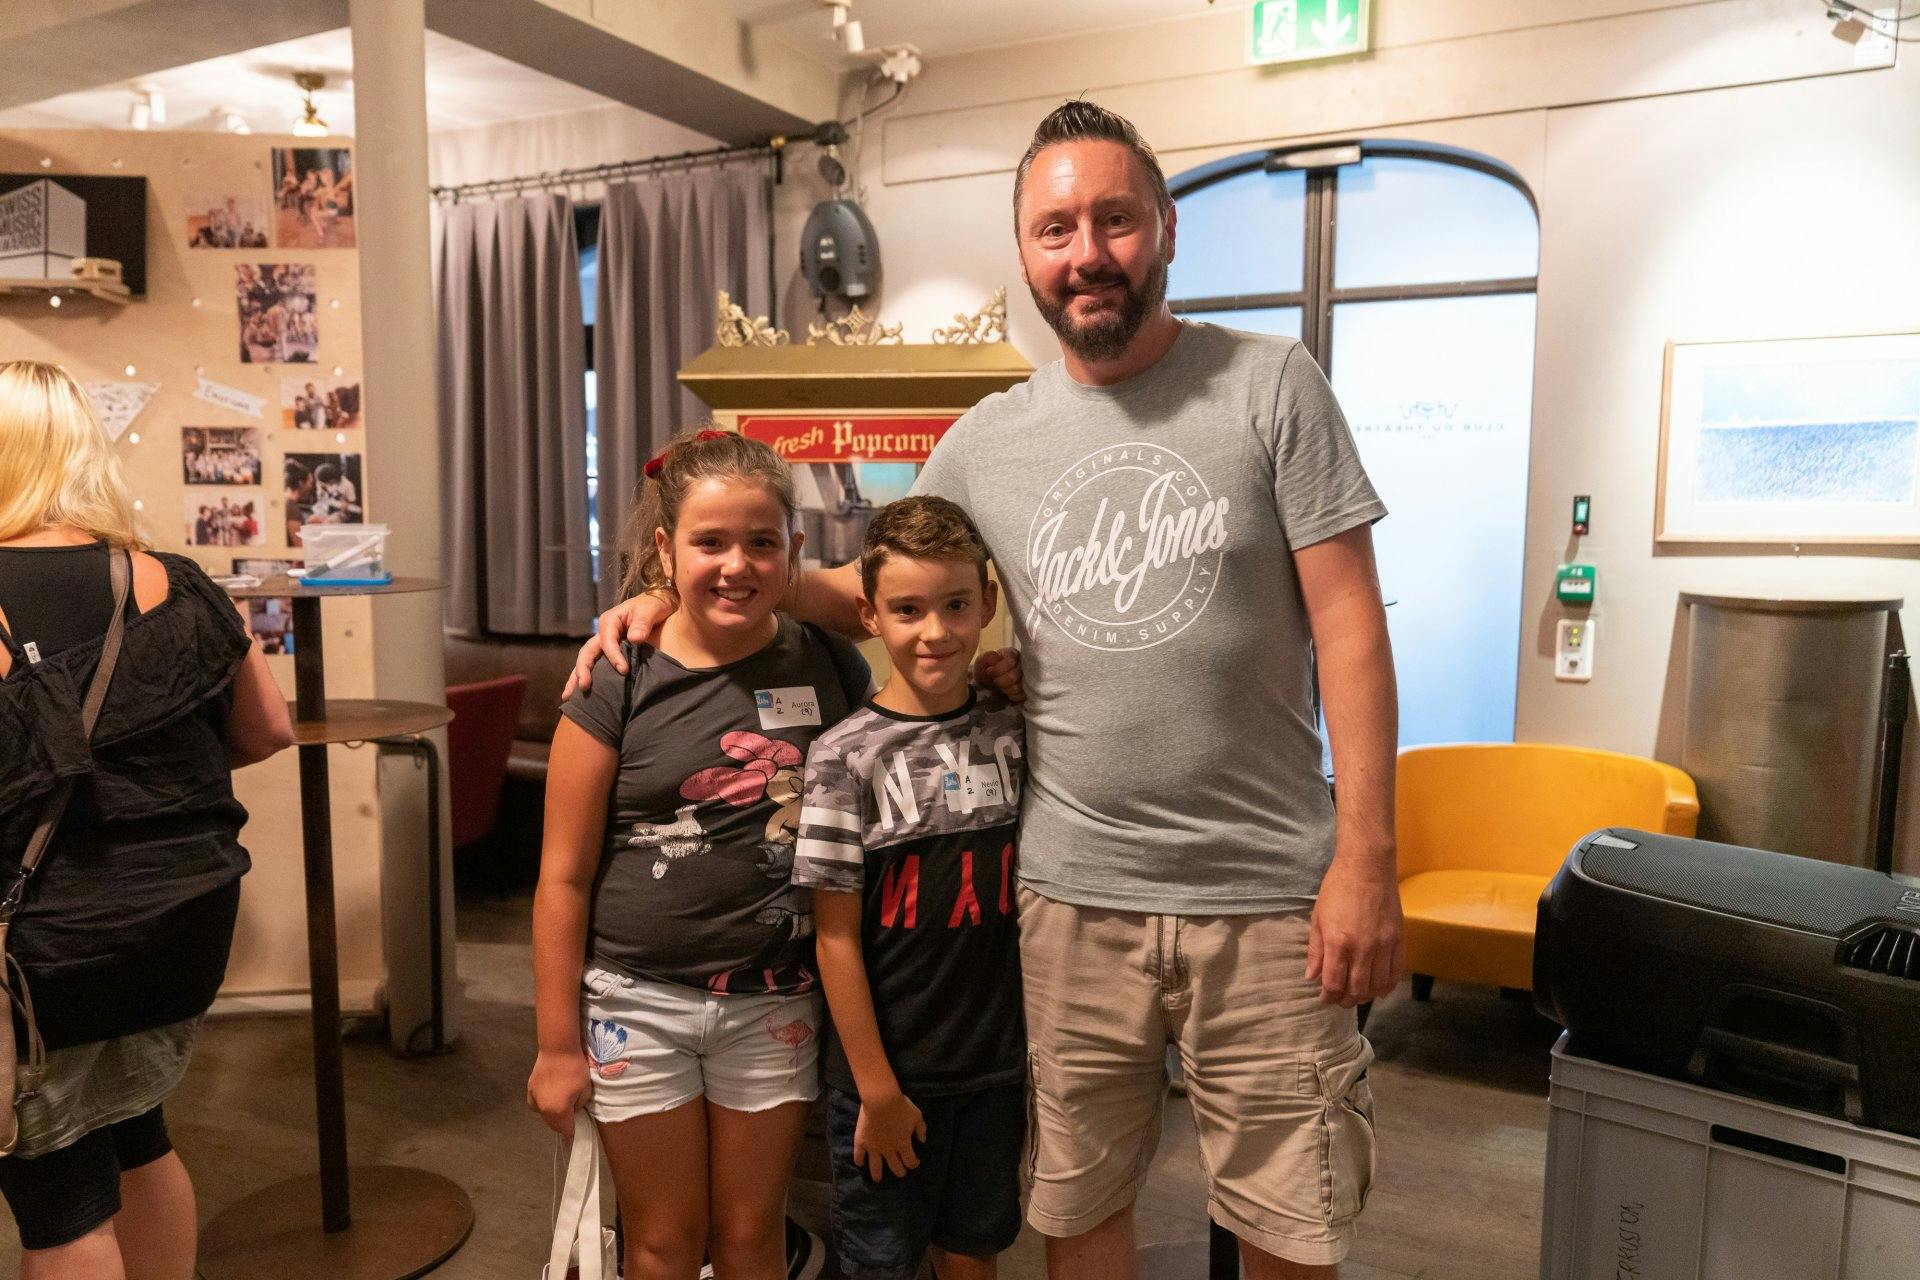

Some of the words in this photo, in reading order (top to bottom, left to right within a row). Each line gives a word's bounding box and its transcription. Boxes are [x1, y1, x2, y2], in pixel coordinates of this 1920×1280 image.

[773, 426, 824, 455] fresh
[832, 421, 936, 457] Popcorn
[791, 701, 815, 709] Aurora
